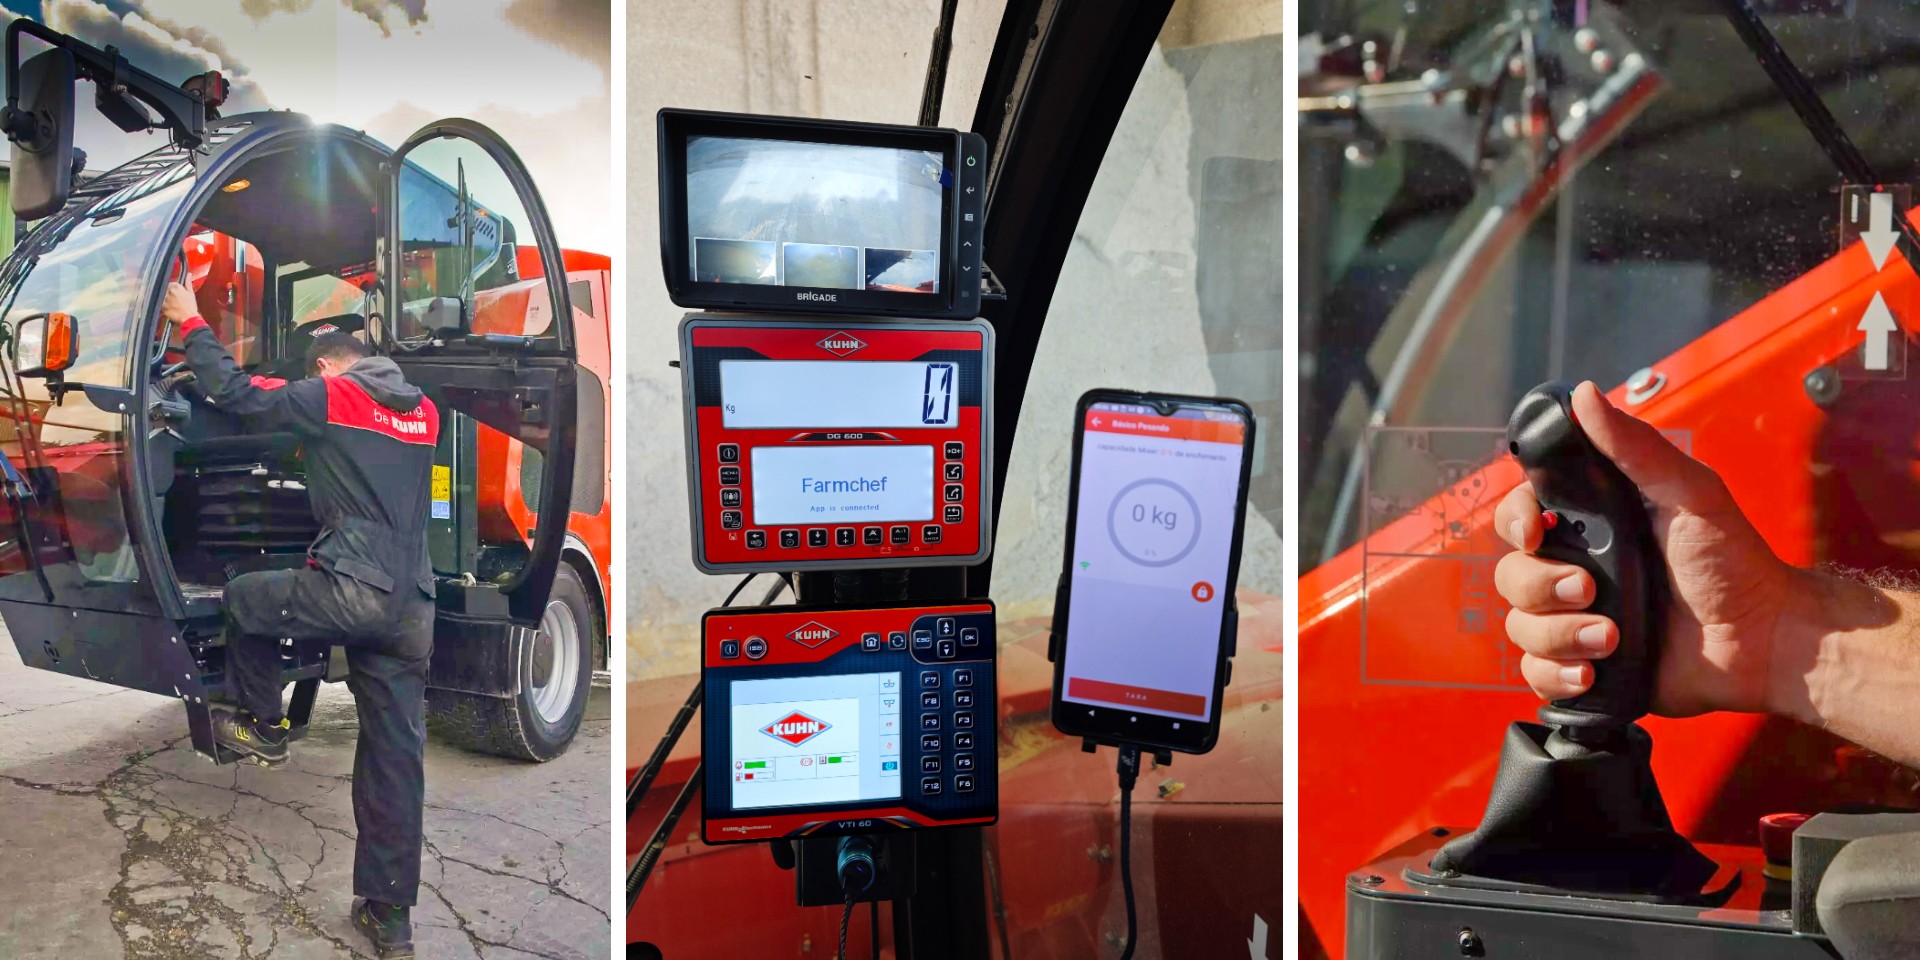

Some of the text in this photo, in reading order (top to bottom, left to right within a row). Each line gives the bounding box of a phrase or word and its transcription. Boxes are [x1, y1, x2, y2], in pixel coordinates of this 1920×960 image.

[797, 291, 837, 302] BRIGADE
[824, 340, 859, 349] KUHN
[922, 363, 953, 424] 0
[726, 404, 735, 413] Kg
[374, 408, 427, 434] be KUHN
[1137, 421, 1170, 432] Pesando
[802, 476, 888, 494] Farmchef
[810, 505, 825, 513] App
[840, 504, 879, 512] connected
[1132, 504, 1177, 531] 0 kg
[794, 629, 831, 641] KUHN
[924, 676, 937, 684] F7
[924, 697, 937, 705] F8
[925, 718, 937, 726] F9
[958, 716, 970, 724] F3
[772, 721, 820, 736] KUHN
[958, 737, 971, 745] F4
[925, 761, 938, 769] F11
[958, 758, 971, 766] F5
[924, 782, 940, 790] F12
[959, 780, 971, 788] F6
[838, 820, 872, 829] VTI 60
